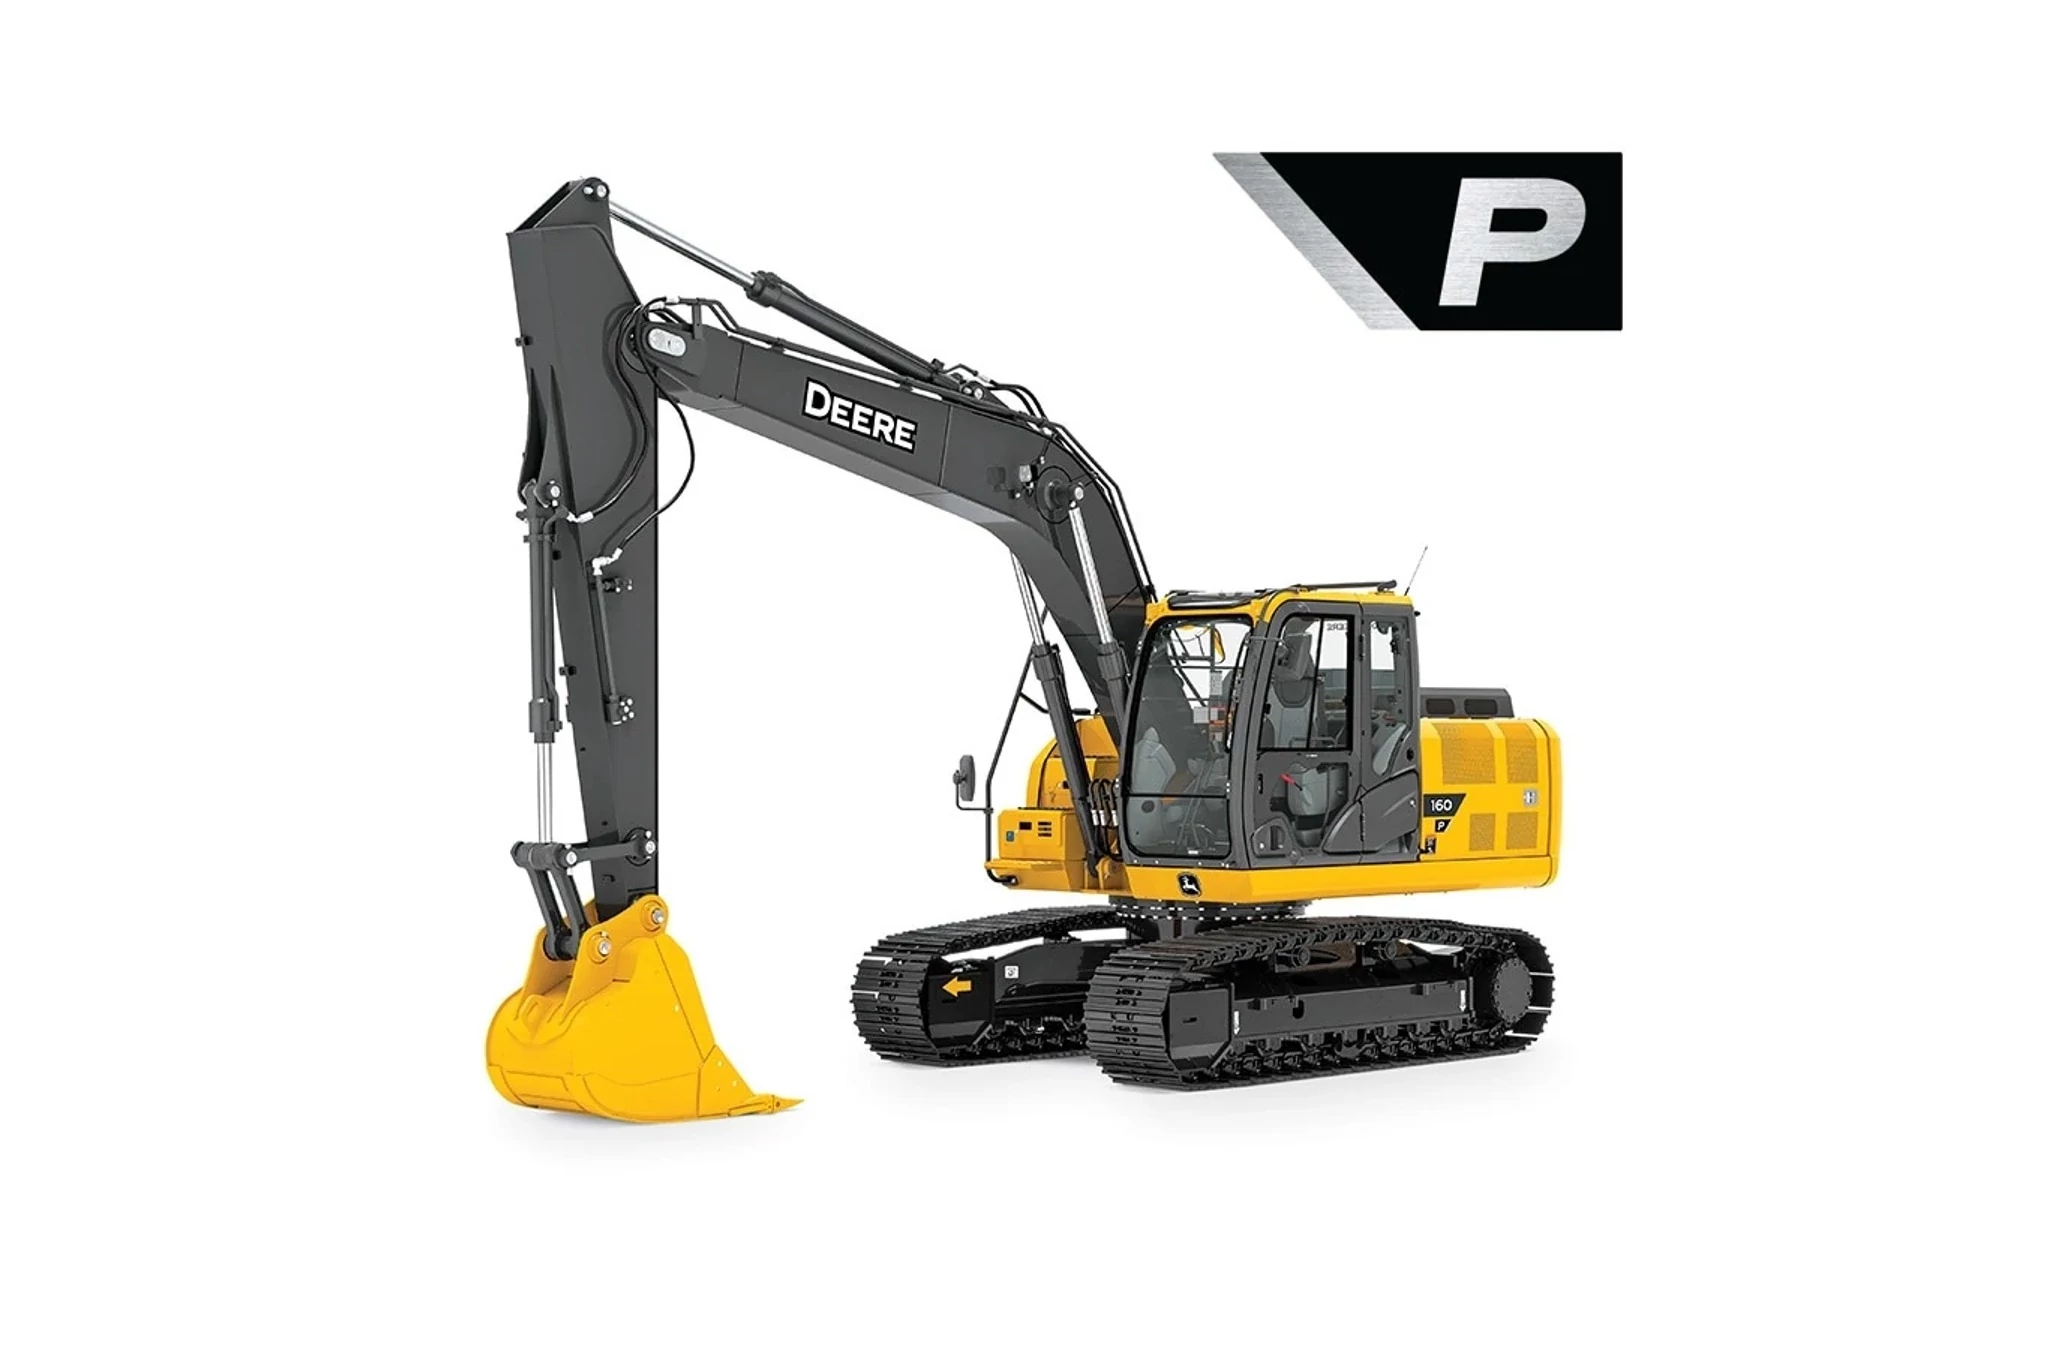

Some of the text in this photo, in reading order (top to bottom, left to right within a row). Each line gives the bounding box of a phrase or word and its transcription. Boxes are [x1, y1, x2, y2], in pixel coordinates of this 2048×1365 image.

[804, 380, 916, 450] DEERE
[1430, 799, 1453, 811] 160
[1437, 821, 1445, 831] P
